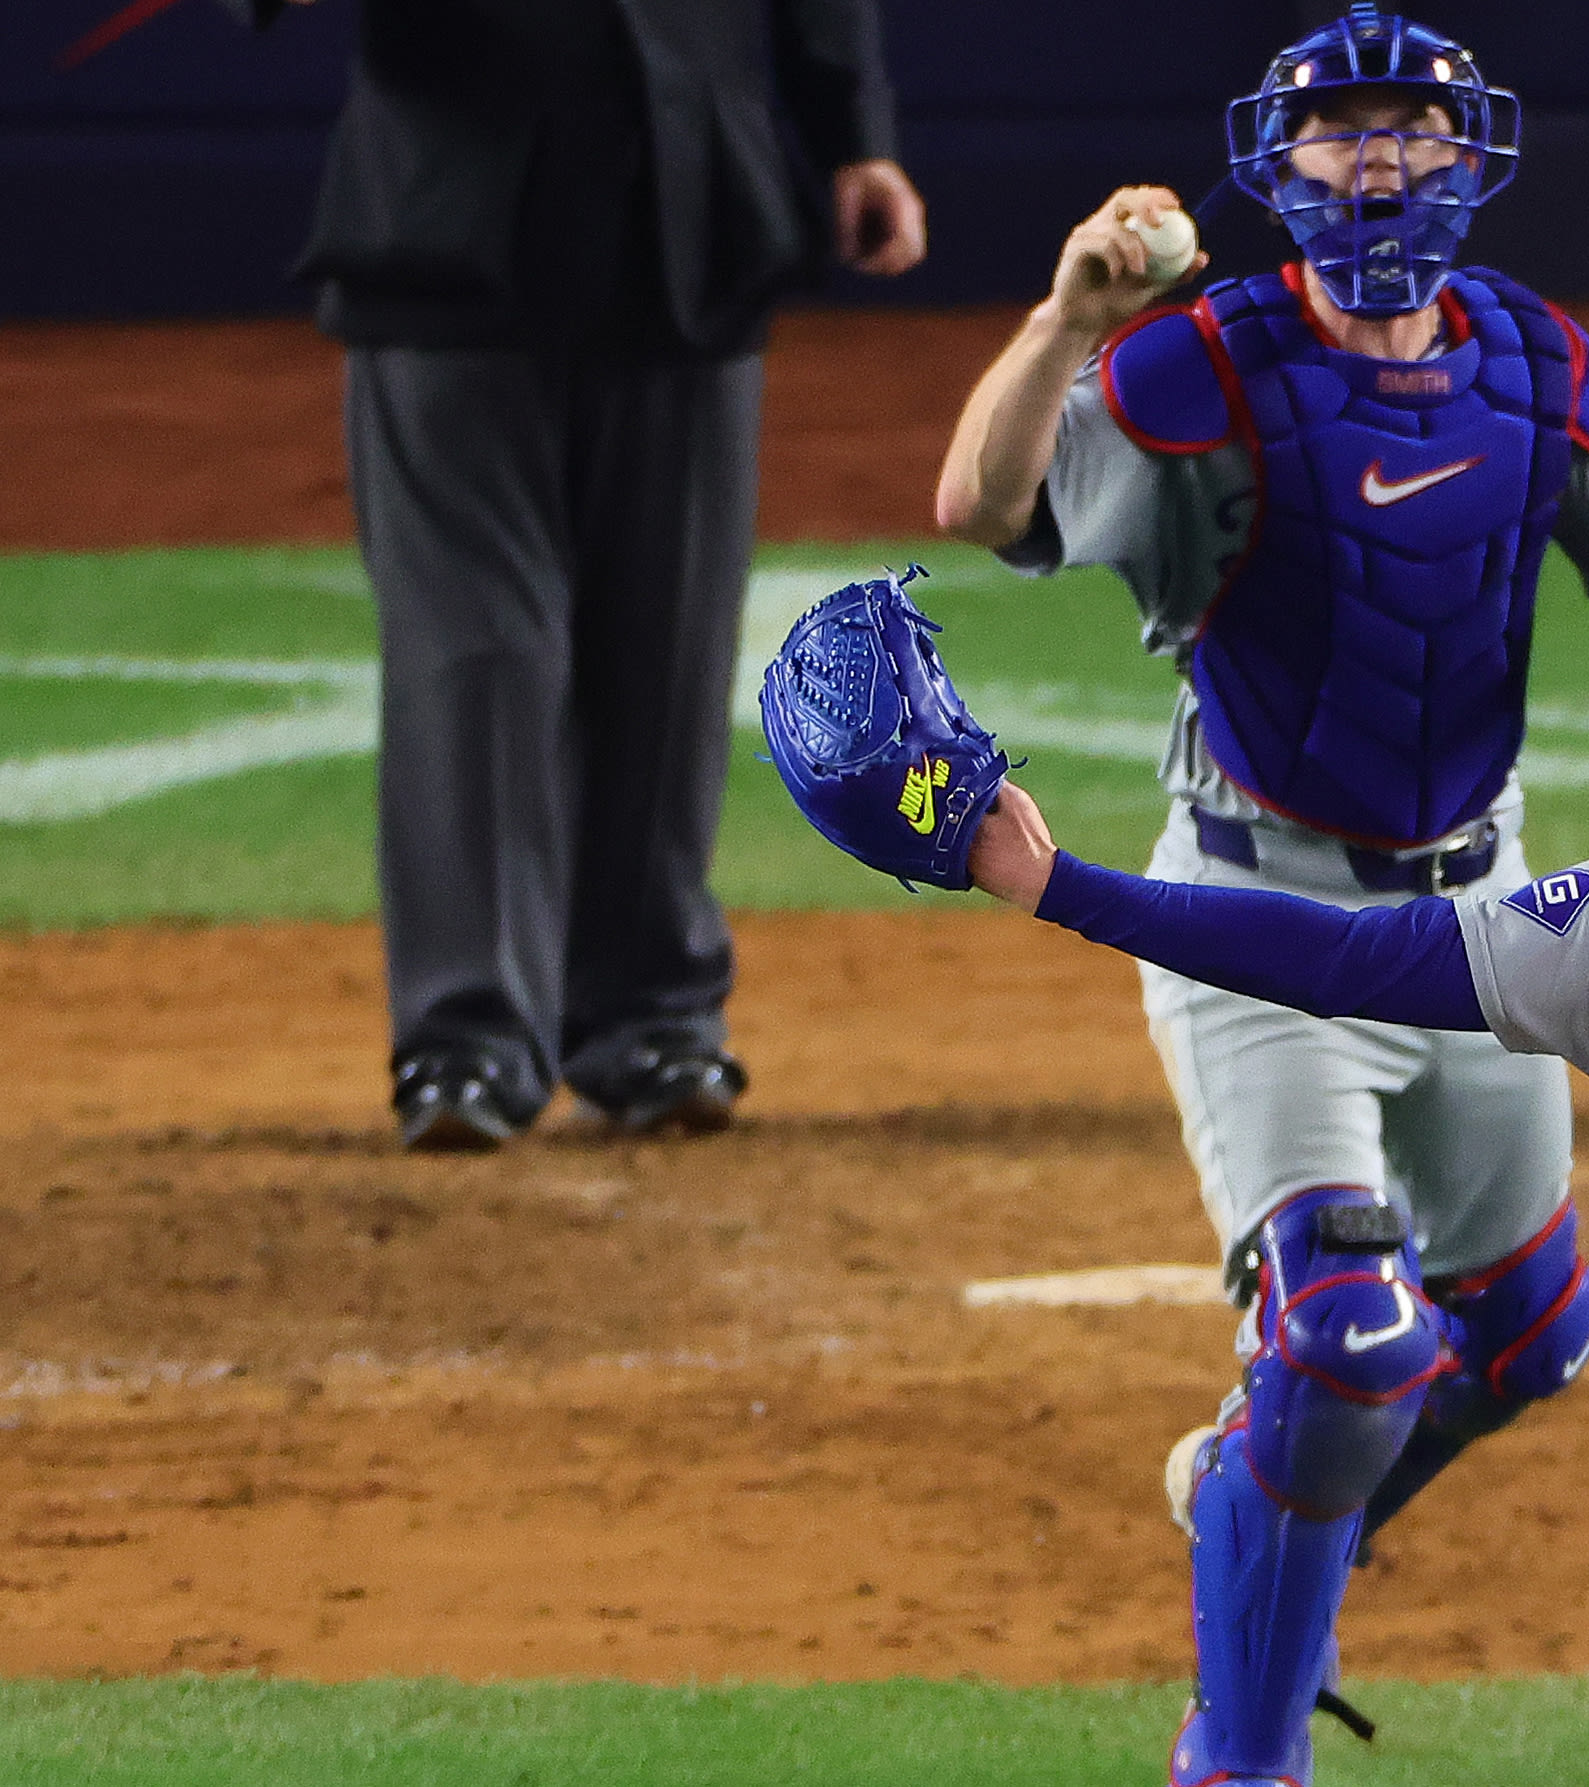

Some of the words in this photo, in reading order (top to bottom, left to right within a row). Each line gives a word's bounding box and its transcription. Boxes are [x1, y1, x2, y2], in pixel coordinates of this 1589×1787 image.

[1377, 369, 1451, 394] SMITH
[932, 759, 950, 788] WB
[897, 766, 926, 821] NIKE
[1542, 874, 1579, 904] G
